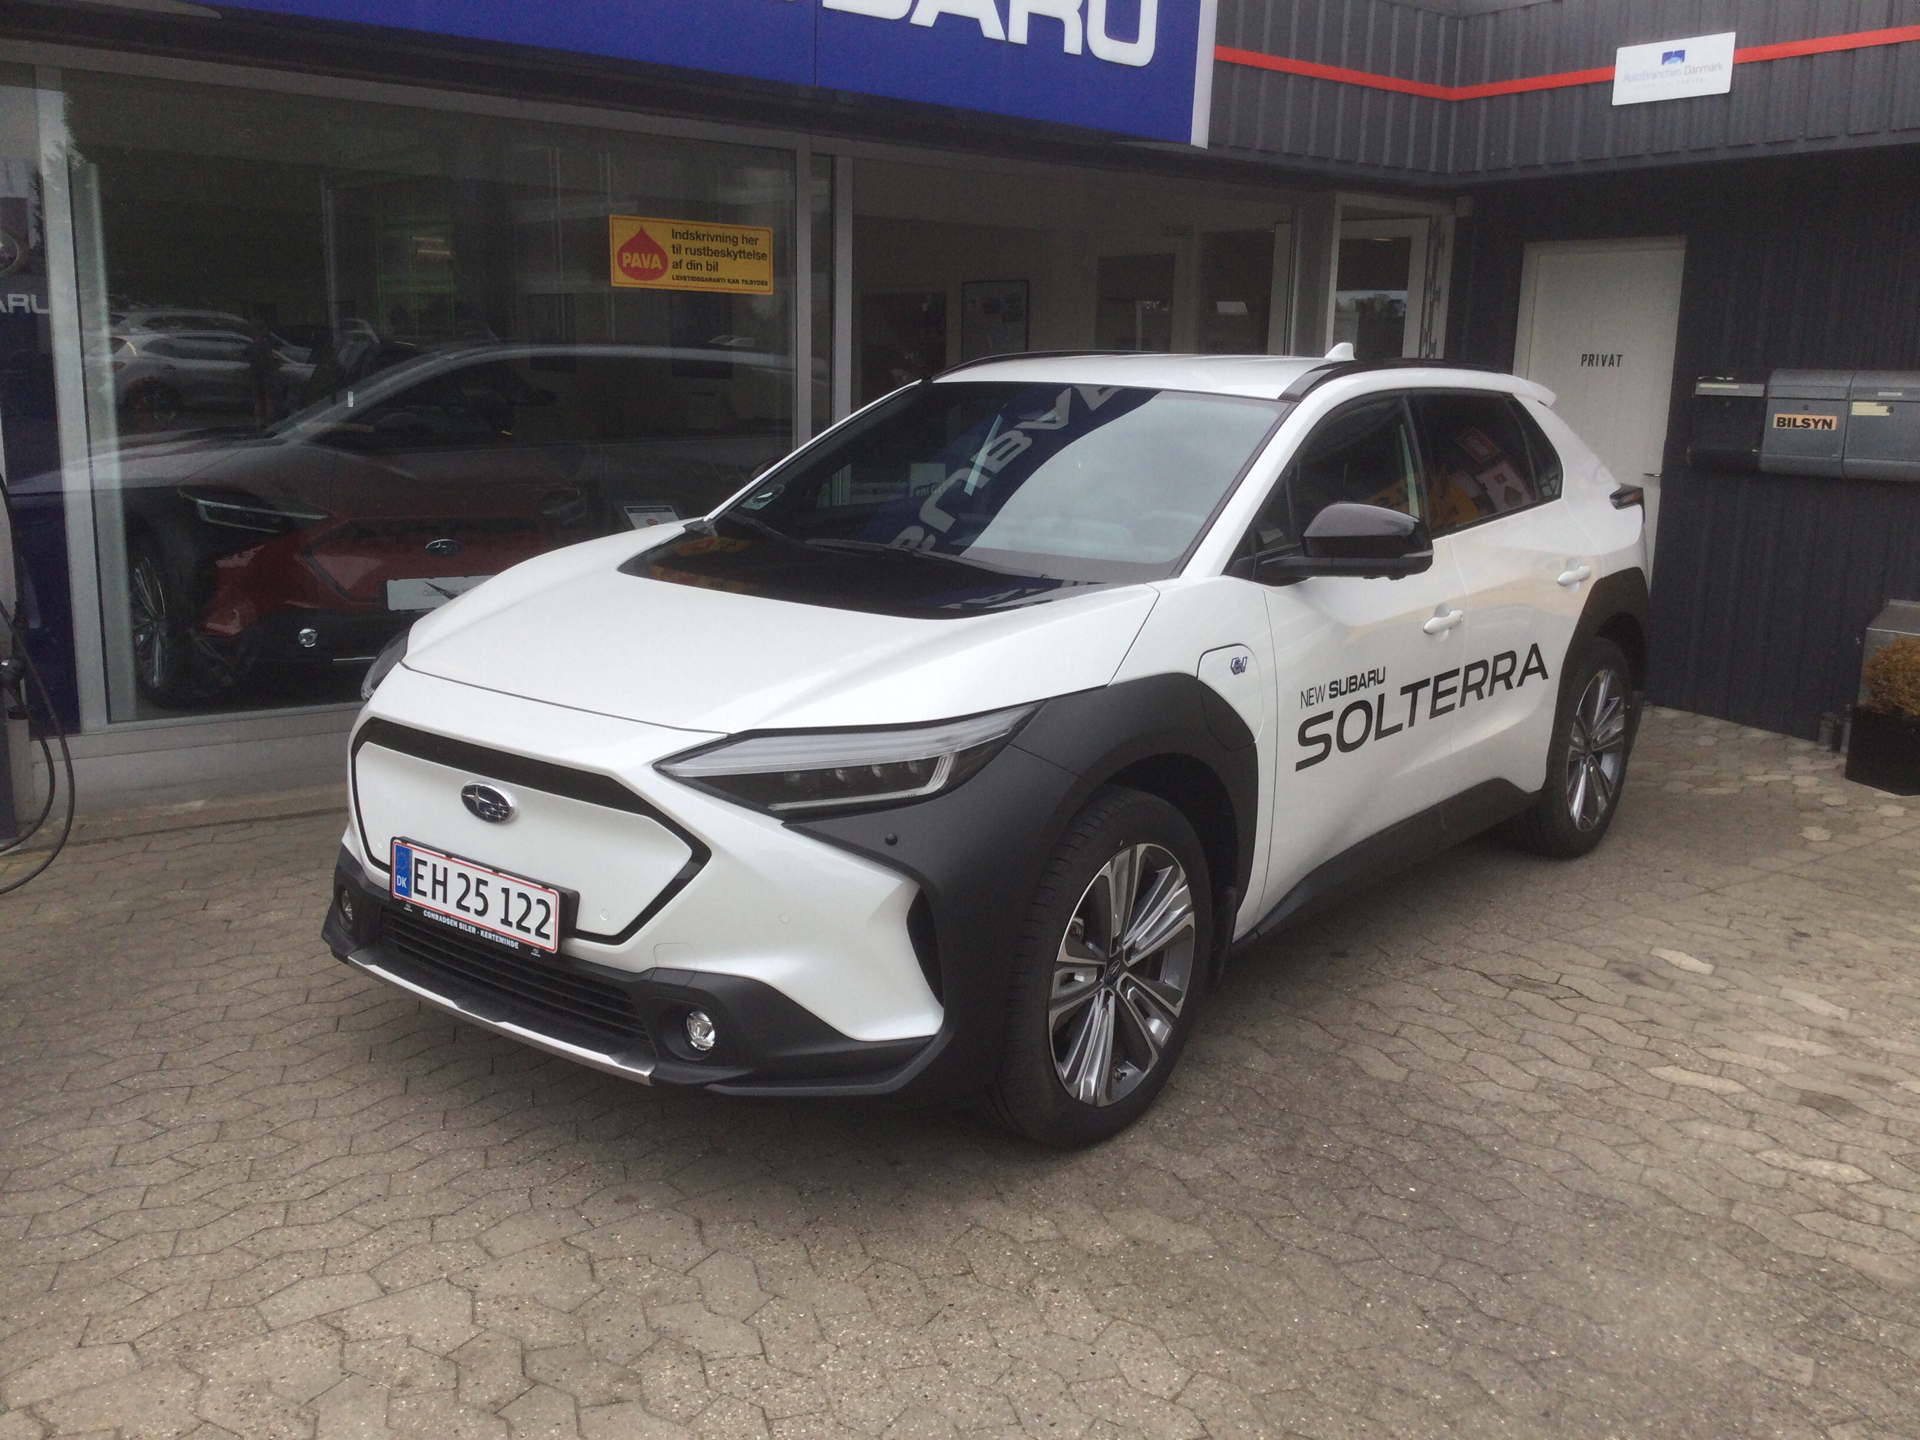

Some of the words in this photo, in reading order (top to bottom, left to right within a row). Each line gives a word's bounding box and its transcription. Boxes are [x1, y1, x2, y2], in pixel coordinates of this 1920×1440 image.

[1622, 67, 1682, 82] AutoBranchen
[1684, 62, 1723, 76] Danmark
[671, 228, 739, 246] Indskrivning
[741, 234, 759, 246] her
[671, 243, 682, 255] til
[685, 246, 768, 260] rustbeskyttelse
[622, 252, 663, 270] PAVA
[671, 259, 683, 270] af
[686, 259, 703, 271] din
[705, 260, 719, 272] bil
[671, 275, 726, 284] LEVETIDSGARANTI
[1580, 353, 1623, 368] PRIVAT
[1776, 417, 1833, 430] BILSYN
[1300, 684, 1326, 709] NEW
[1328, 666, 1386, 699] SUBARU
[1295, 642, 1549, 772] SOLTERRA
[396, 874, 407, 889] DK
[413, 857, 448, 904] EH
[456, 872, 489, 917] 25
[500, 887, 551, 941] 122
[423, 909, 458, 928] CONRADSEN
[459, 921, 477, 934] BILER
[480, 930, 519, 950] KERTEMINDE
